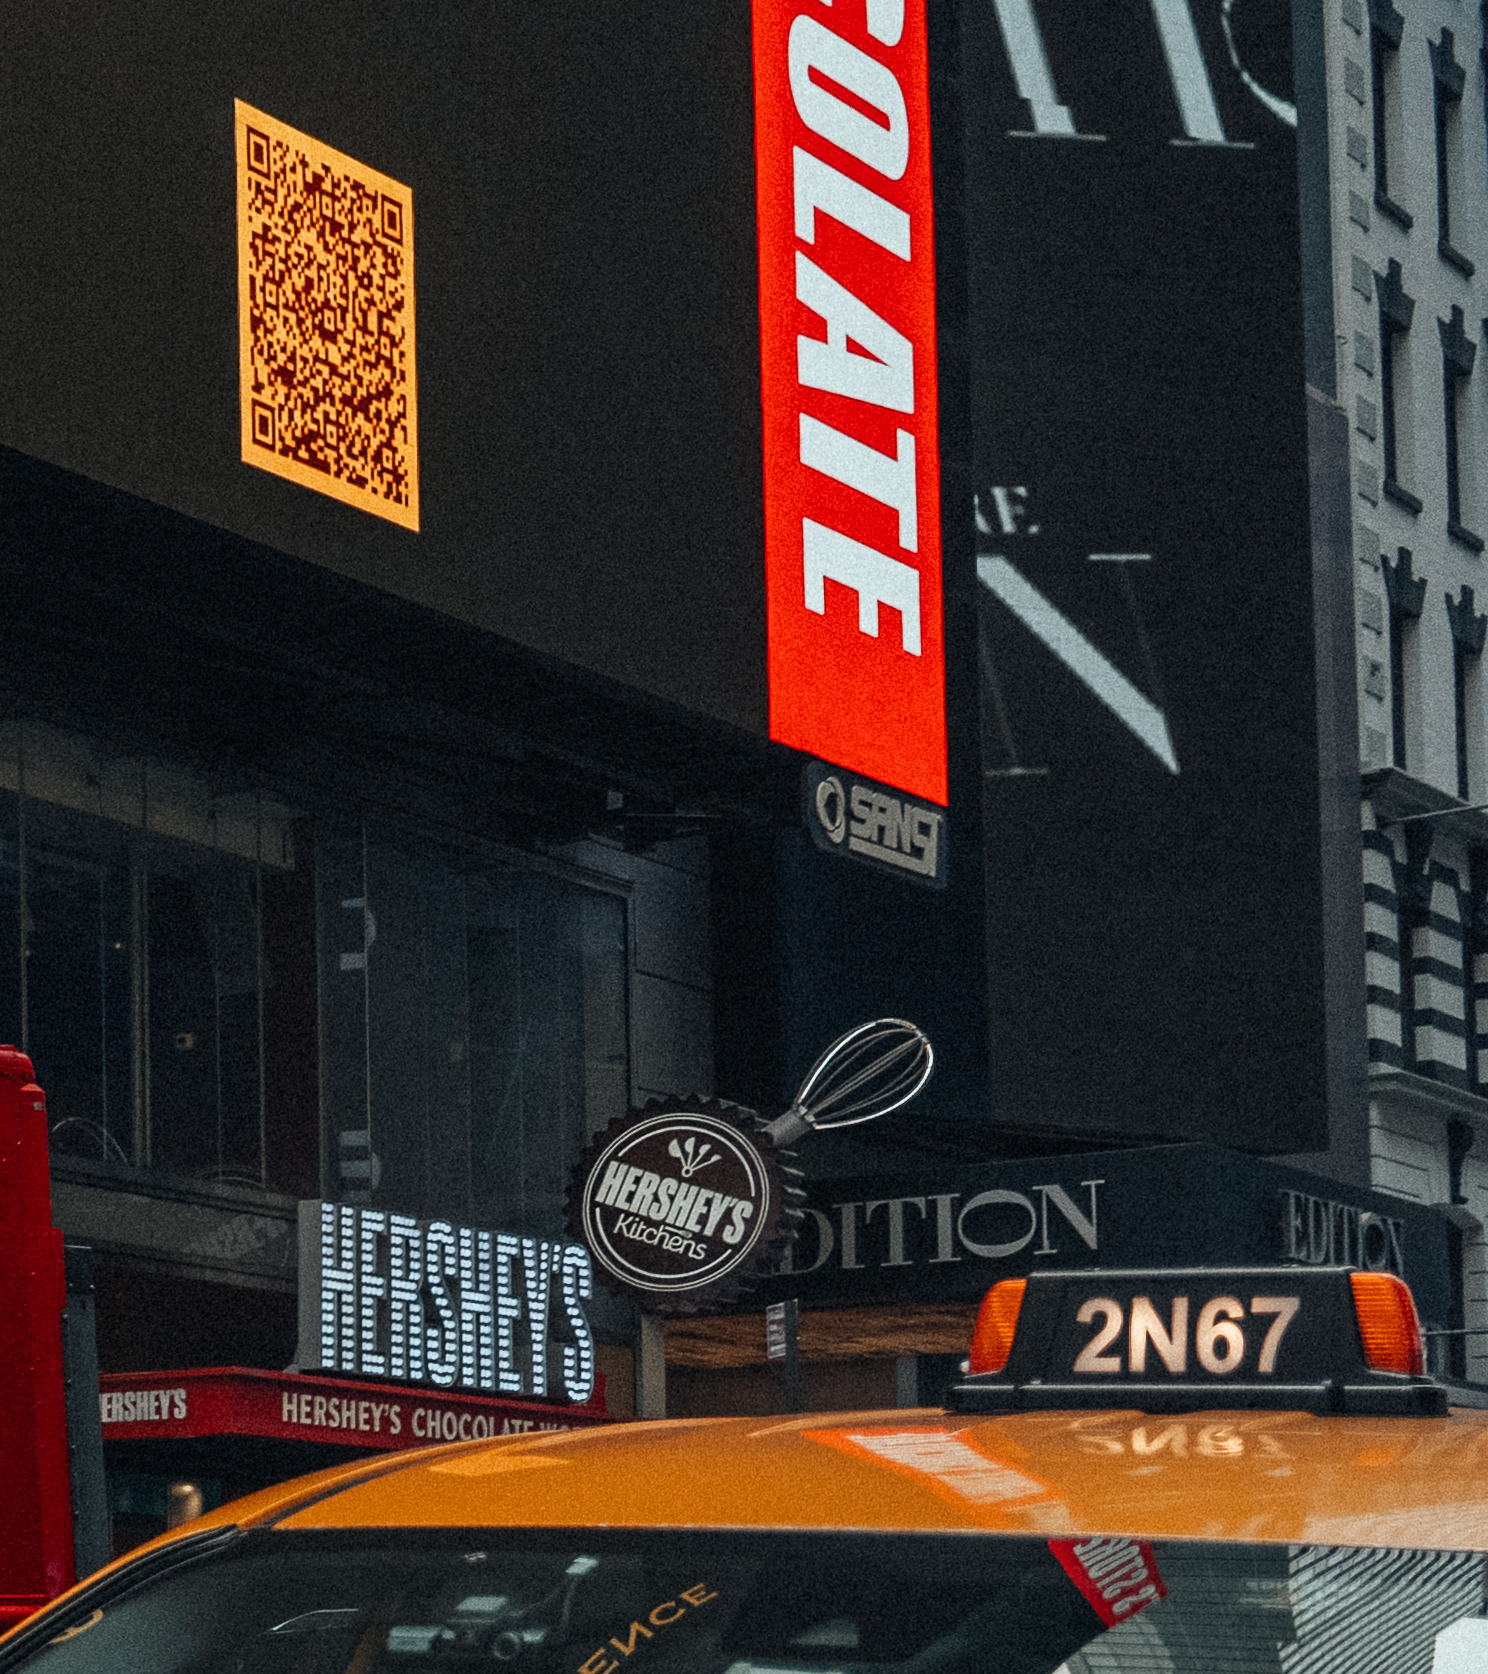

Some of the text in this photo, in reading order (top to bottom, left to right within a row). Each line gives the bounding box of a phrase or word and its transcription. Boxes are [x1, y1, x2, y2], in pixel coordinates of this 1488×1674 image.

[595, 1161, 754, 1245] HERSHEY'S
[613, 1213, 707, 1260] Kitchens
[766, 1180, 1105, 1277] DITION
[1285, 1191, 1405, 1278] EDITION
[320, 1202, 595, 1404] HERSHEY'S
[1072, 1295, 1301, 1376] 2N67
[100, 1388, 187, 1423] ERSHEY'S
[282, 1392, 401, 1435] HERSHEY'S
